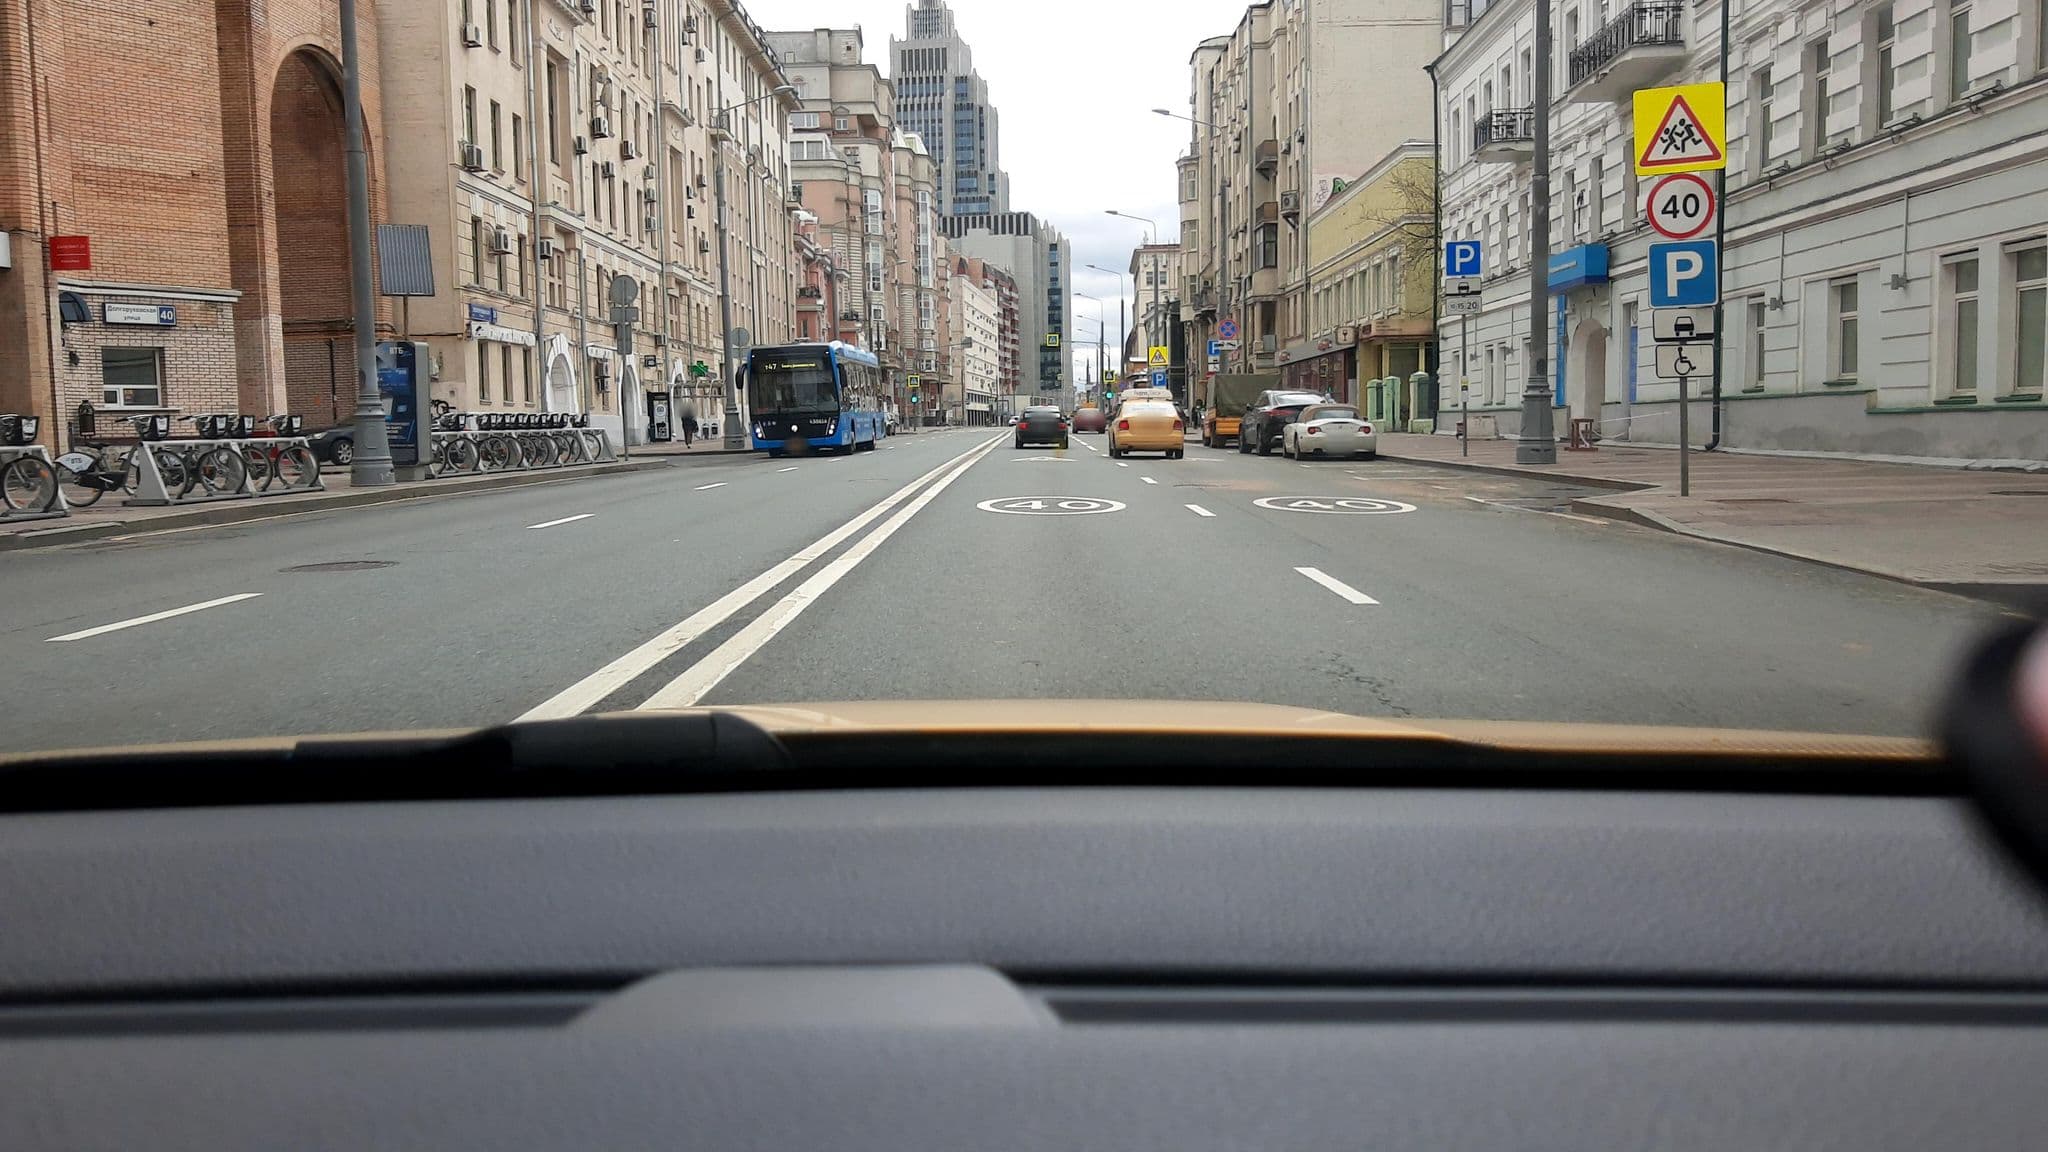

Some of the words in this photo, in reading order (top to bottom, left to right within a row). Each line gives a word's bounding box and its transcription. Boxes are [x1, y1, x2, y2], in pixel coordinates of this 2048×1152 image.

[1661, 193, 1700, 219] 40
[1456, 244, 1475, 273] P
[1666, 251, 1704, 298] P
[160, 310, 174, 320] 40
[389, 346, 404, 355] ВТБ
[1155, 373, 1164, 385] P
[1004, 500, 1101, 510] 40
[1288, 500, 1387, 510] 40
